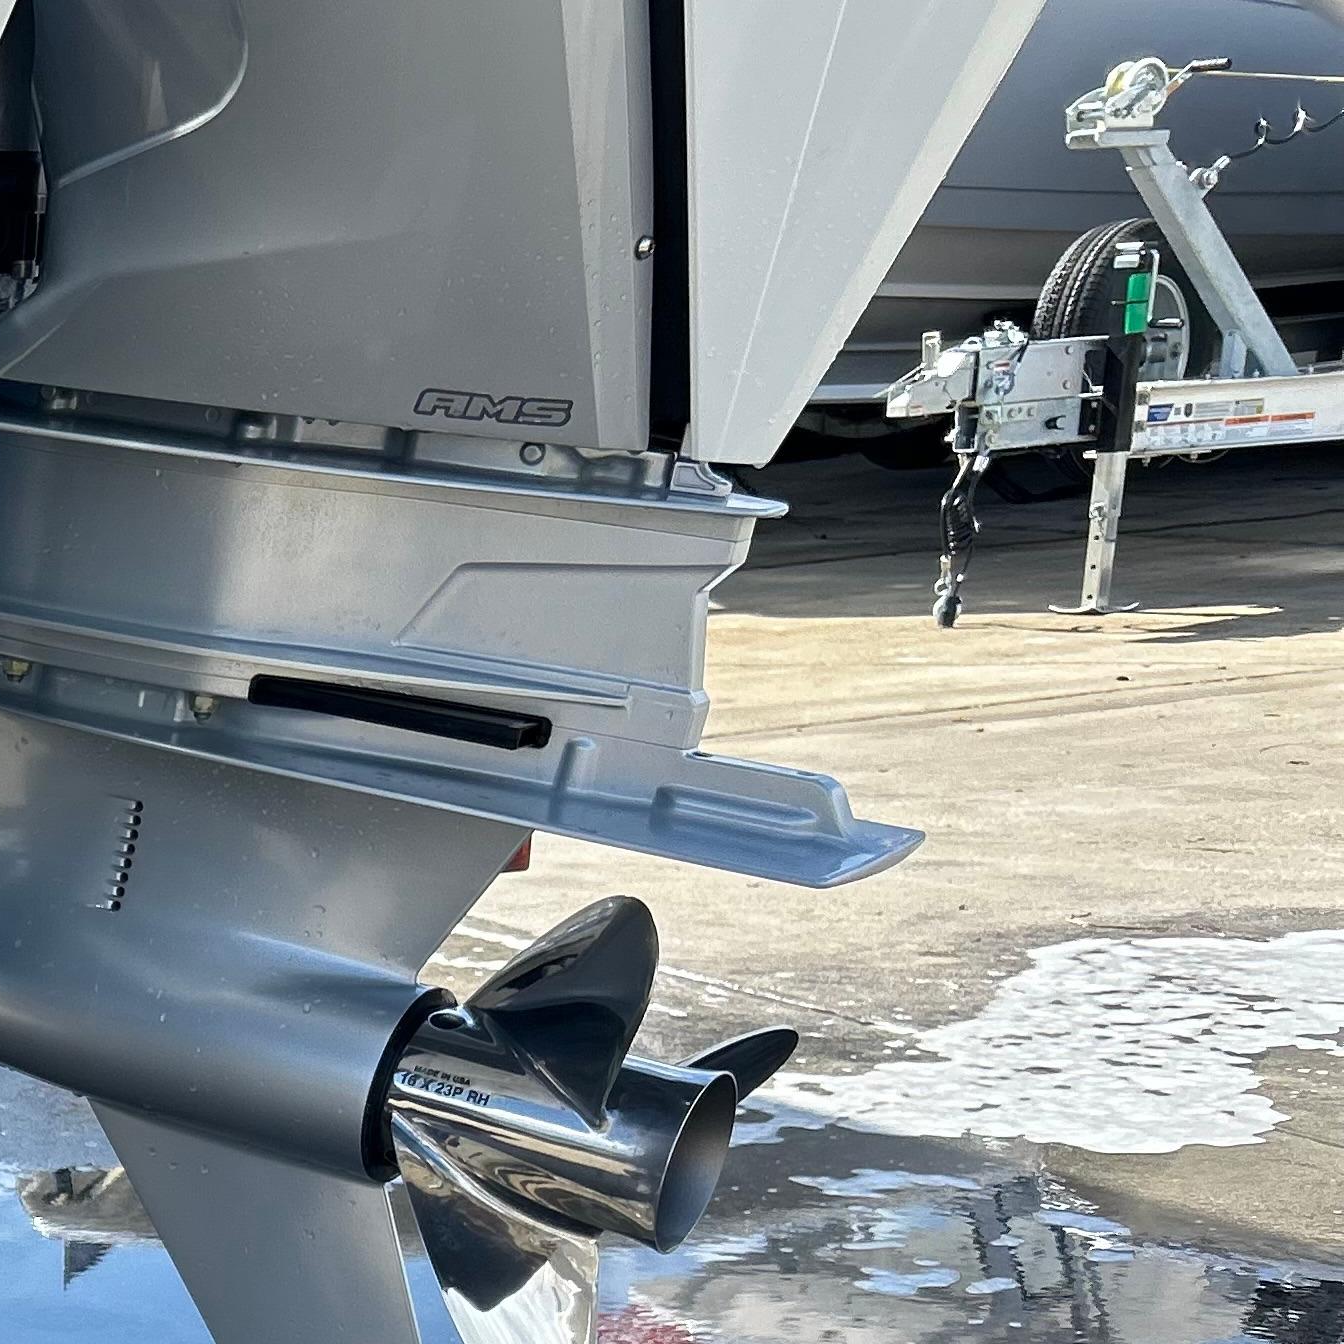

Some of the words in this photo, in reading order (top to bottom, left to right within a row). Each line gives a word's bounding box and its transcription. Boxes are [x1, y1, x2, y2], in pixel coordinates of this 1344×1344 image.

[413, 388, 573, 427] AMS
[414, 1065, 440, 1077] MADE
[452, 1075, 471, 1086] USA
[434, 1081, 464, 1097] 23P
[466, 1089, 491, 1106] RH
